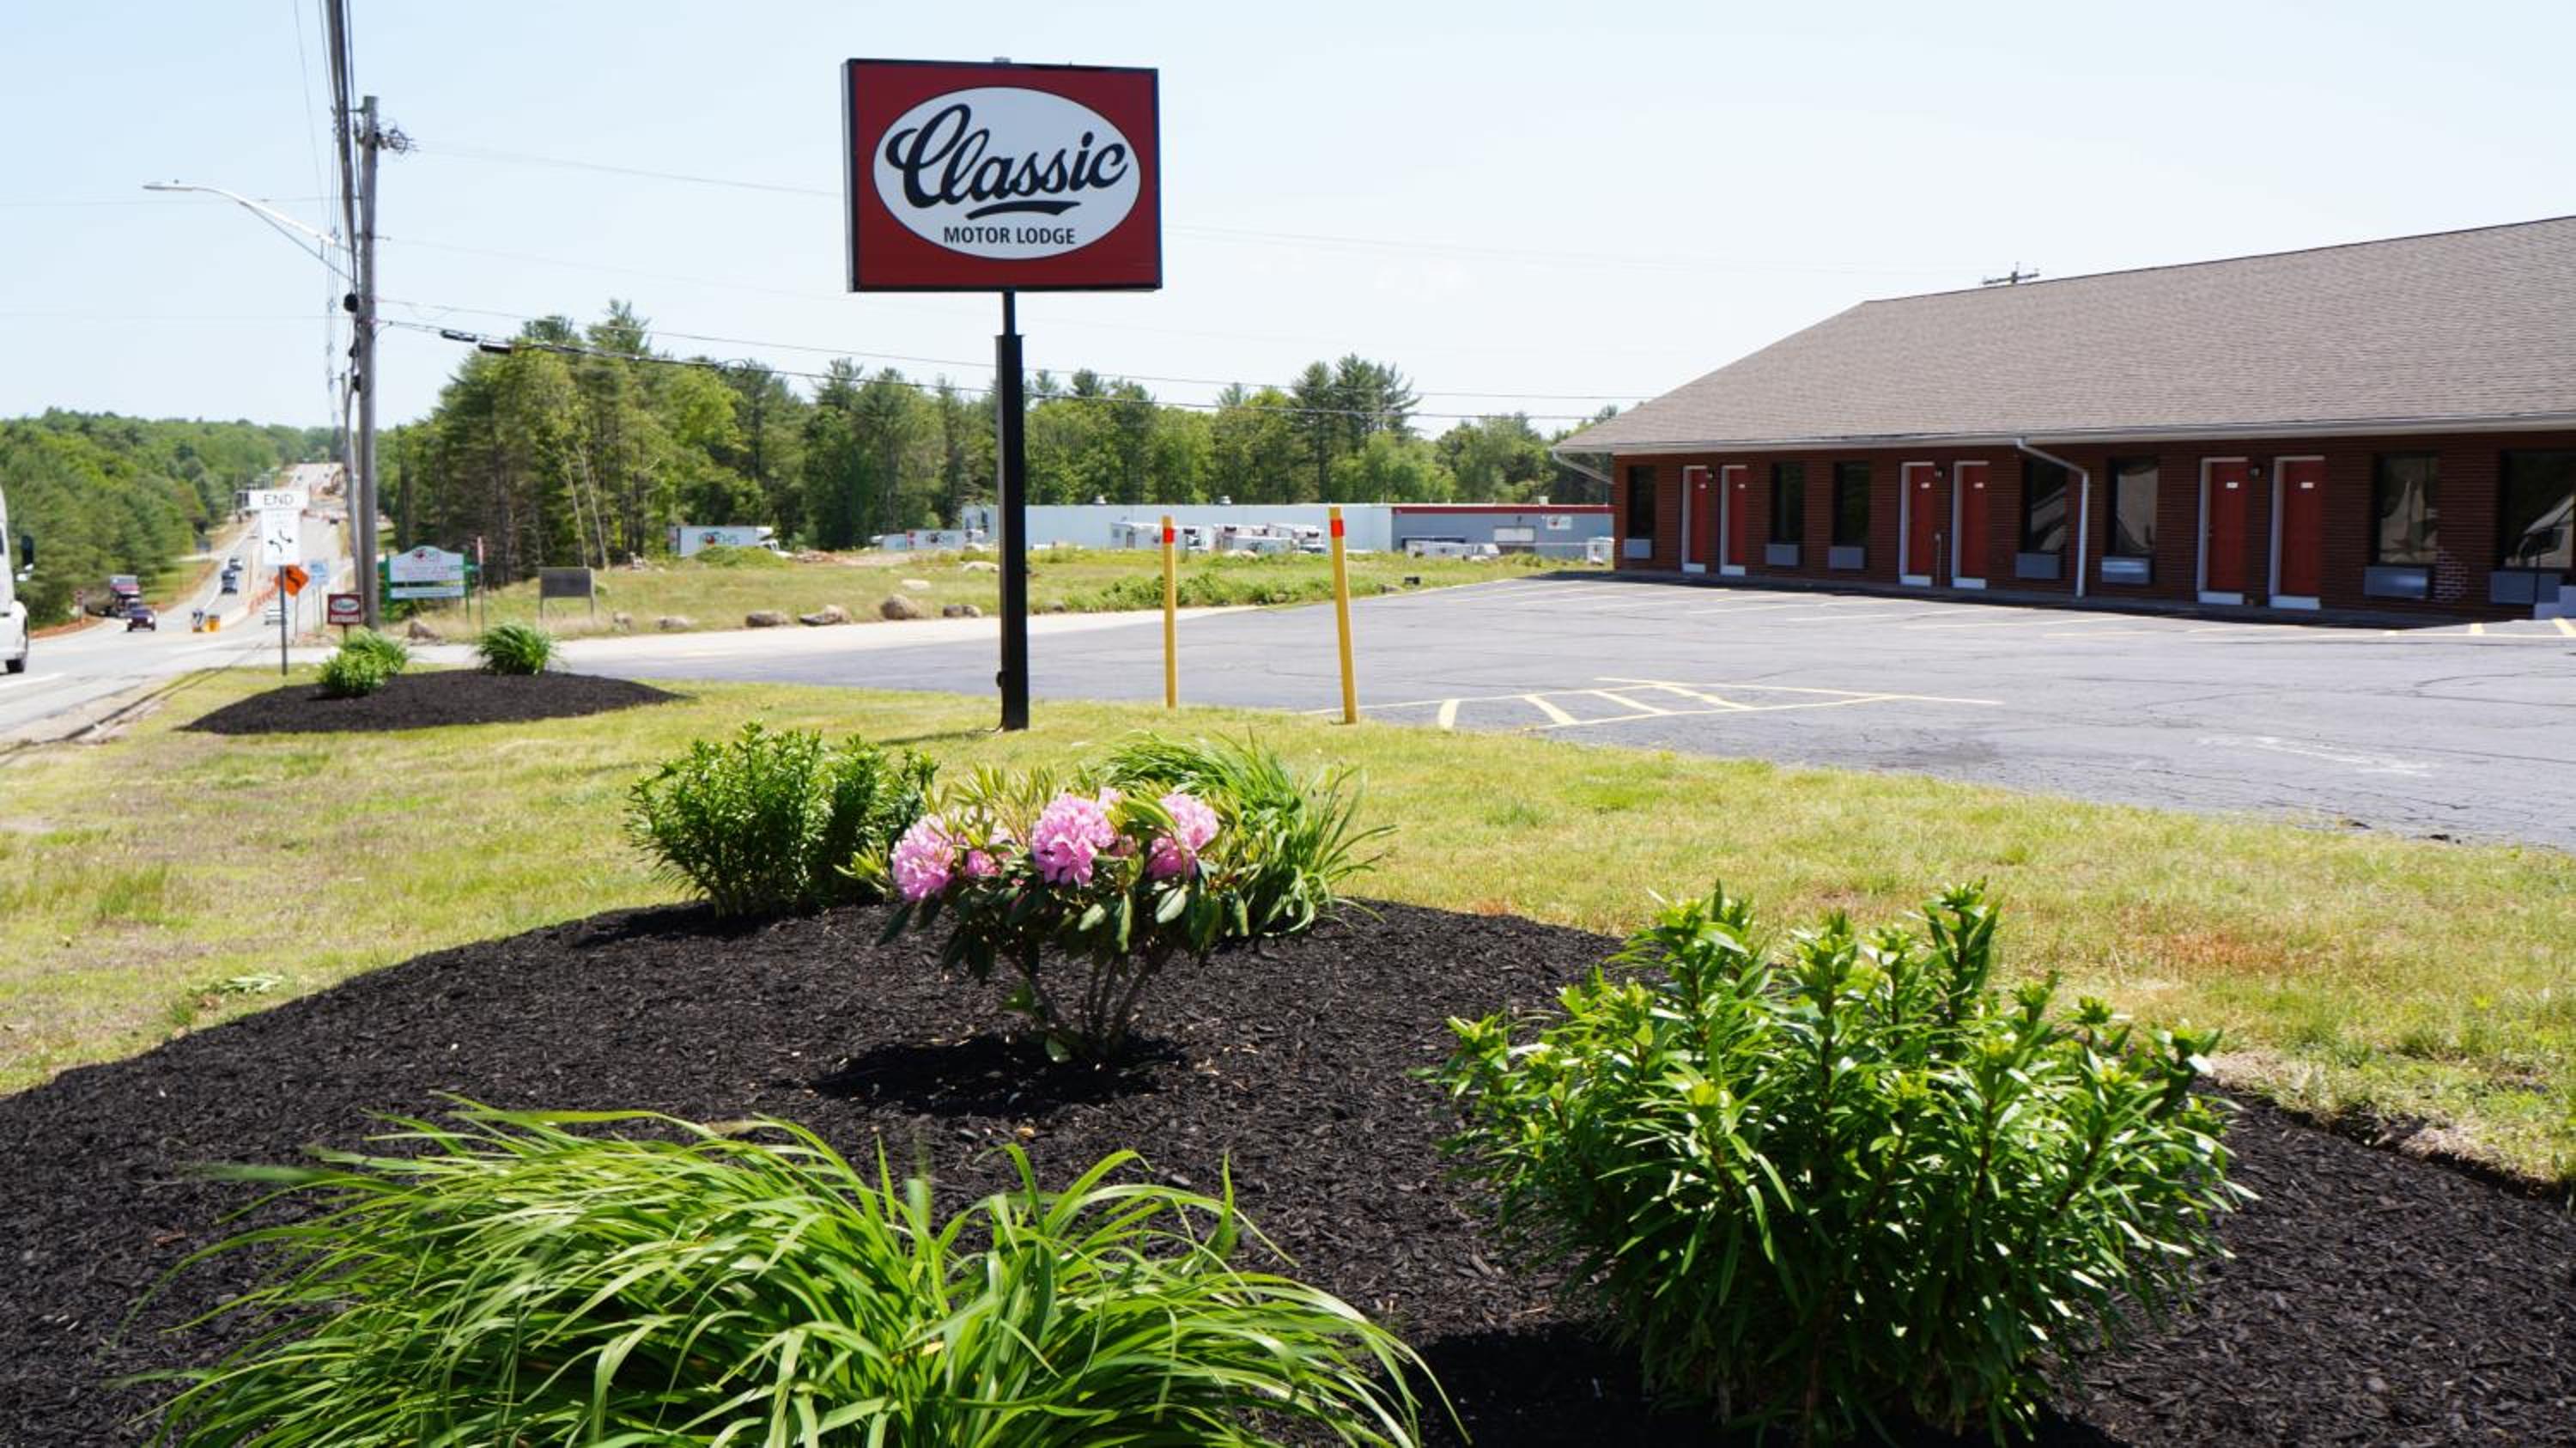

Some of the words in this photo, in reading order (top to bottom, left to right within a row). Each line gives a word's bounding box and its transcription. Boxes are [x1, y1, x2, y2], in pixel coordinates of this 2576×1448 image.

[885, 103, 1129, 209] Classic
[944, 227, 1011, 244] MOTOR
[1016, 227, 1076, 245] LODGE
[264, 494, 294, 506] END
